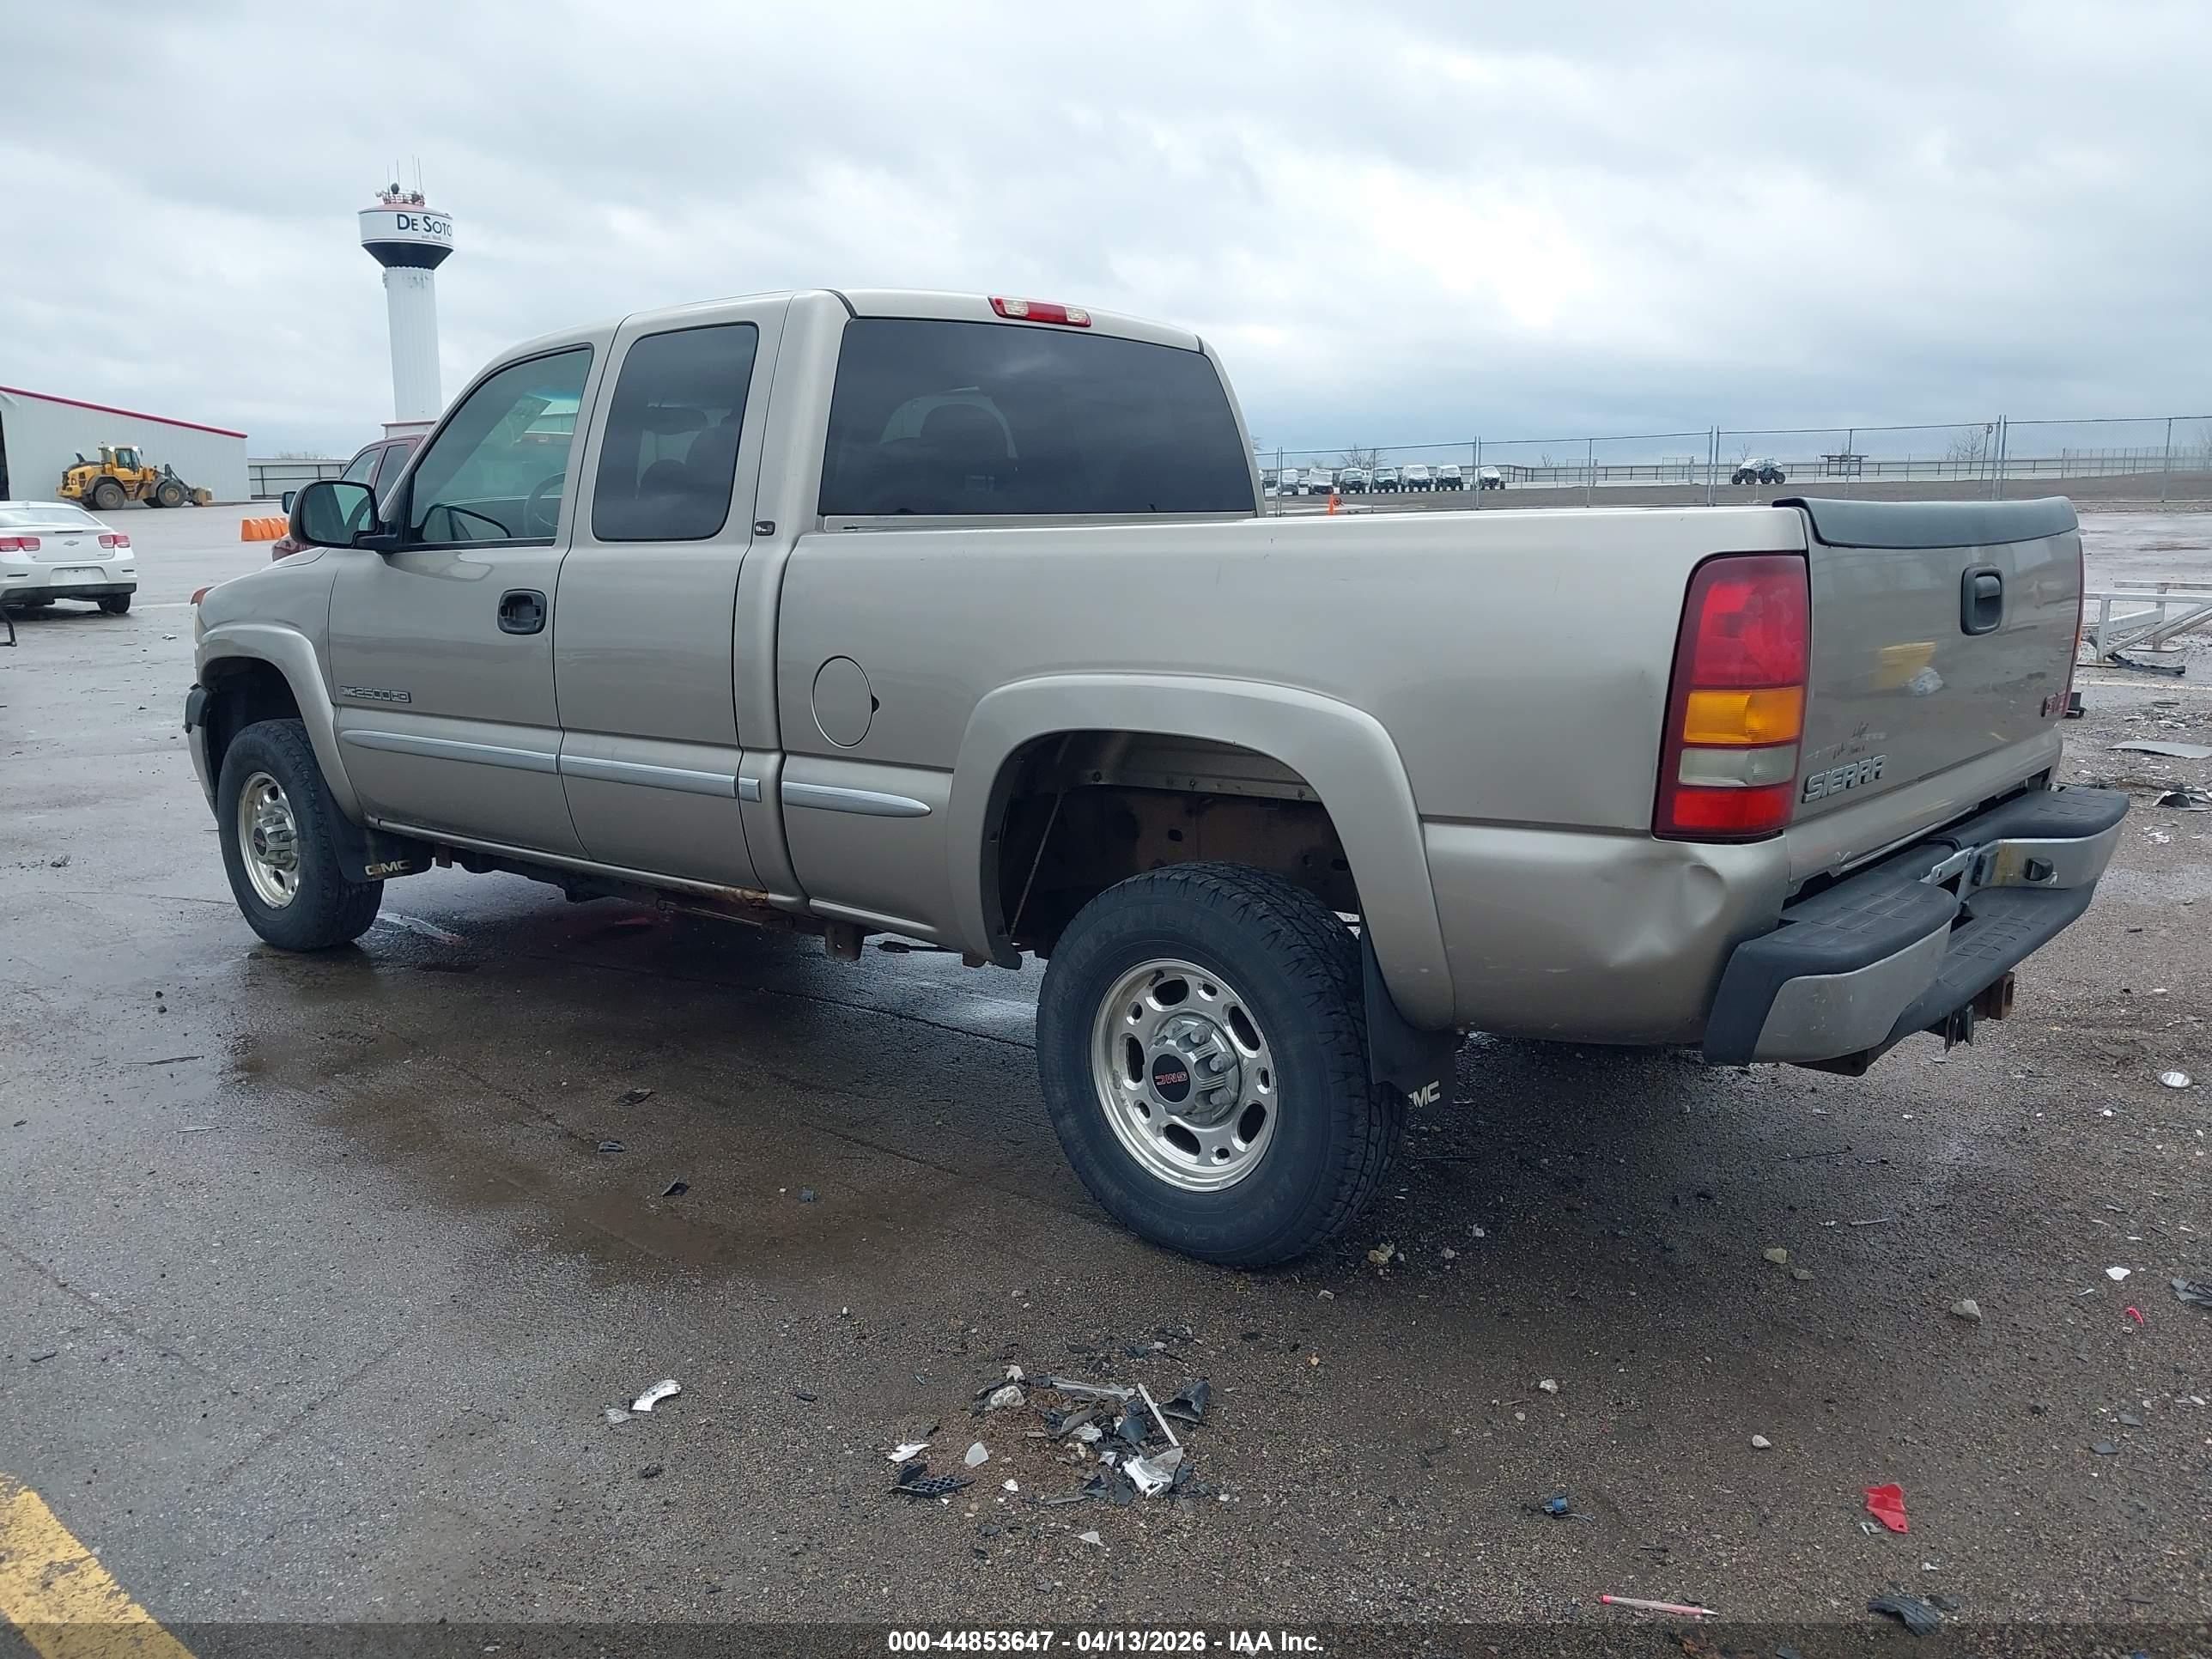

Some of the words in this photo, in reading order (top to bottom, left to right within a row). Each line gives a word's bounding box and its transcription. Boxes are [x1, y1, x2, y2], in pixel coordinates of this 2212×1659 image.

[1802, 754, 1887, 804] SIERRA
[365, 860, 412, 876] GMC
[1155, 1071, 1188, 1085] GMC
[1408, 1080, 1441, 1109] MC
